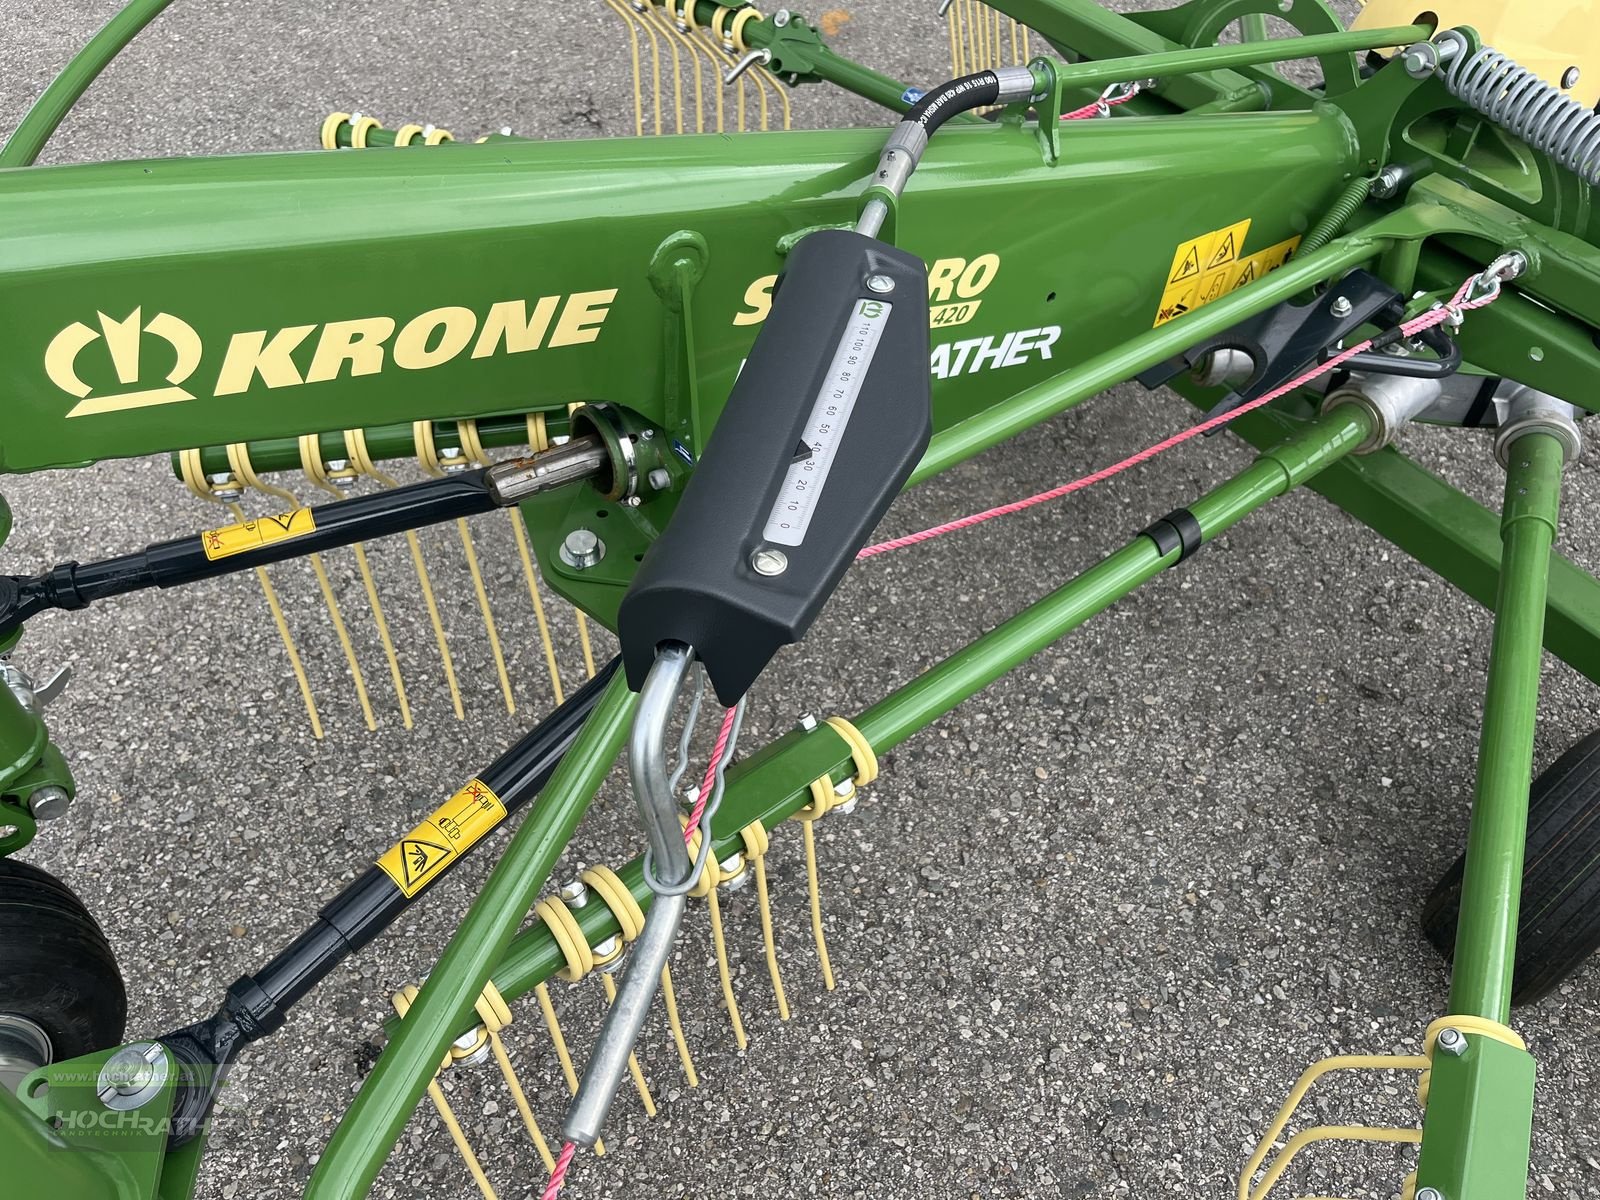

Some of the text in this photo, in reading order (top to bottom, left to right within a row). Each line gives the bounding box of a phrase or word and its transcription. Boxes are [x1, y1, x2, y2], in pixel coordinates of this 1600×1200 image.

[955, 84, 966, 94] WP
[935, 94, 949, 107] BAR
[933, 304, 970, 325] 420
[859, 322, 870, 336] 110
[212, 288, 619, 397] KRONE
[852, 338, 865, 351] 100
[847, 355, 858, 365] 90
[840, 371, 851, 382] 80
[833, 389, 845, 399] 70
[826, 405, 837, 416] 60
[819, 423, 830, 434] 50
[811, 441, 822, 453] 40
[804, 460, 815, 472] 30
[795, 479, 808, 491] 20
[787, 501, 799, 511] 10
